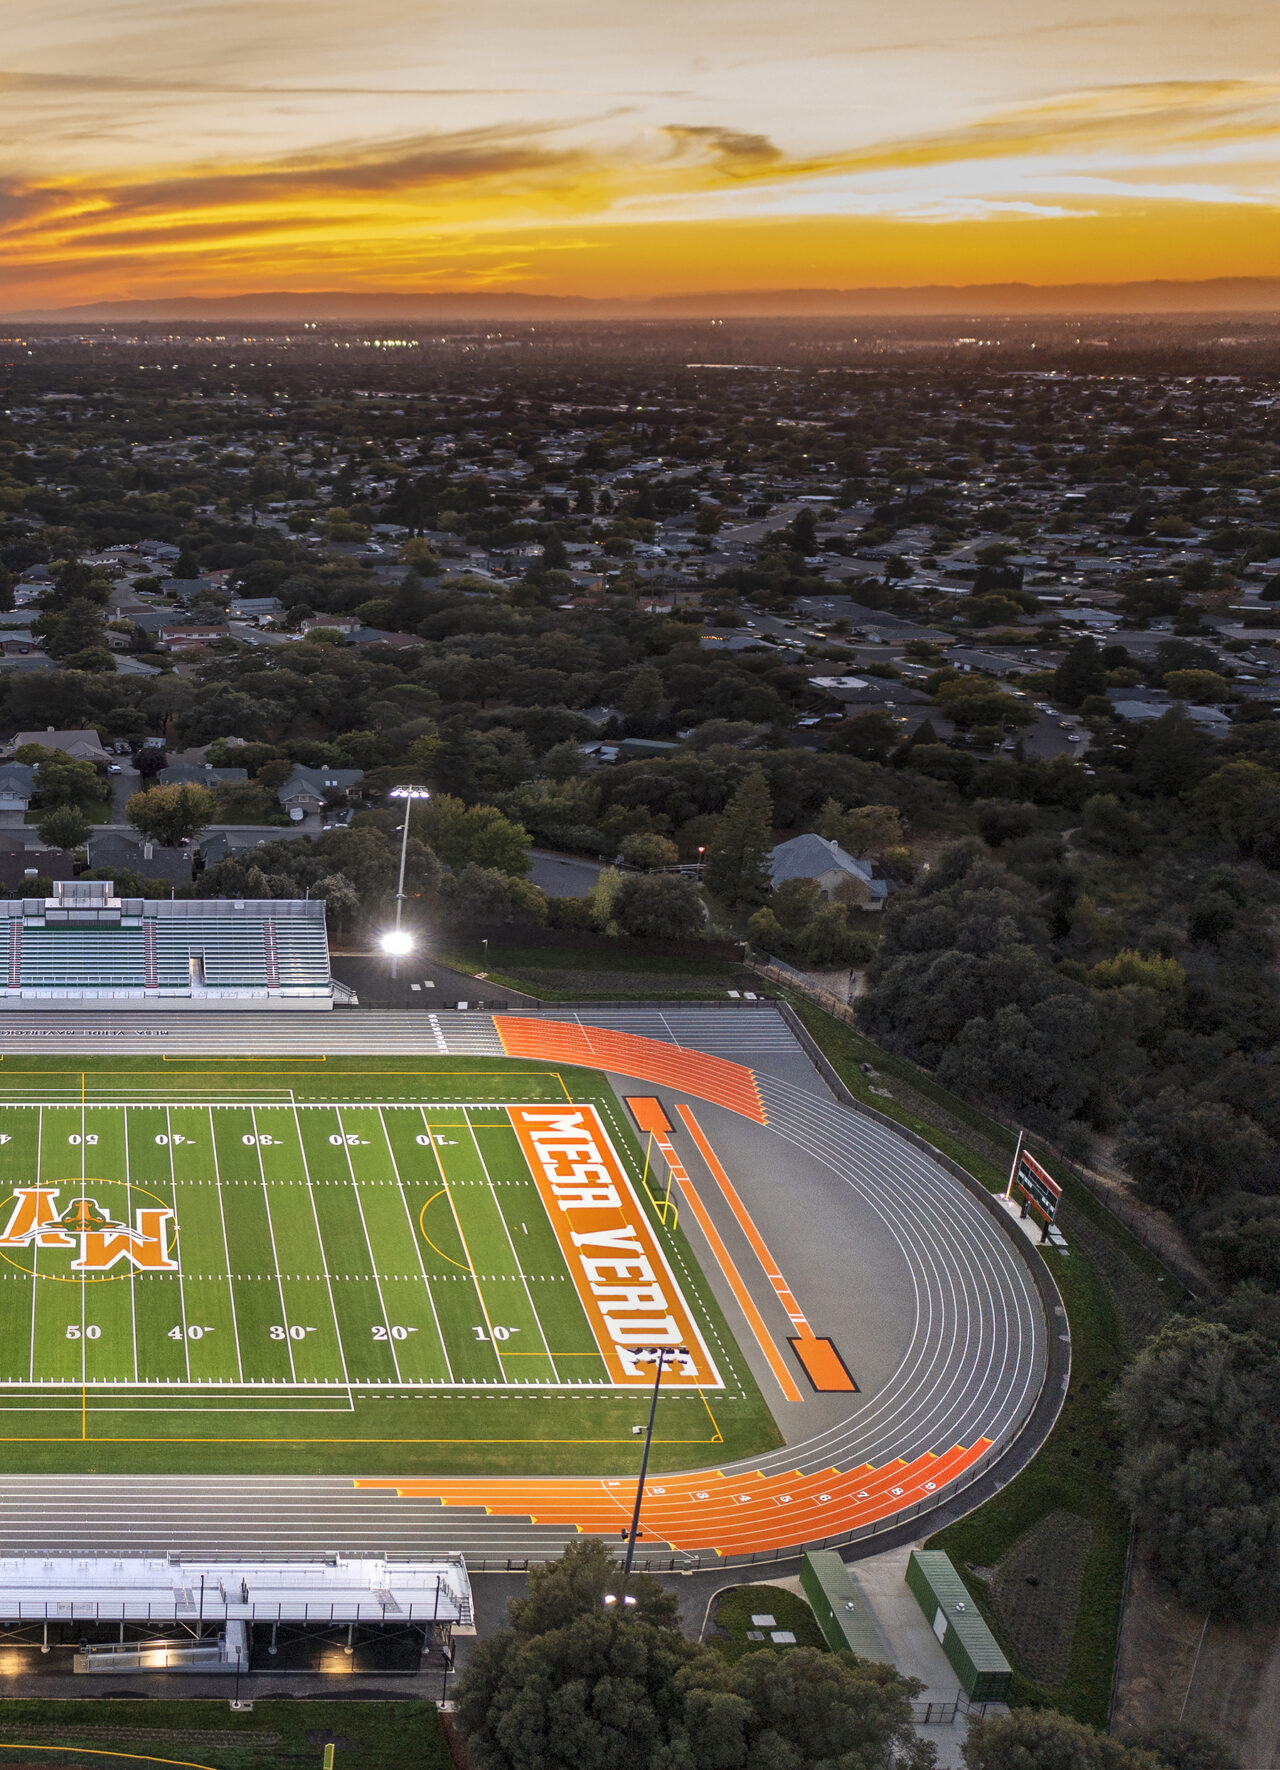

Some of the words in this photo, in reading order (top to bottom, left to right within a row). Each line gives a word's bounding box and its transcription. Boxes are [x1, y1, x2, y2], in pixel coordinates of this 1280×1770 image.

[68, 1133, 99, 1145] 50
[154, 1133, 186, 1145] 40
[241, 1133, 273, 1145] 30
[328, 1133, 360, 1145] 20
[415, 1133, 449, 1145] 10
[521, 1111, 623, 1212] MESA
[571, 1224, 700, 1377] VERDE
[65, 1323, 102, 1340] 50
[167, 1323, 204, 1340] 40
[269, 1323, 306, 1340] 30
[371, 1323, 408, 1340] 20
[472, 1323, 509, 1340] 10
[653, 1487, 666, 1495] 2
[891, 1488, 904, 1496] 8
[924, 1482, 937, 1491] 9
[696, 1492, 709, 1500] 3
[738, 1495, 752, 1503] 4
[780, 1495, 793, 1503] 5
[819, 1494, 832, 1503] 6
[857, 1491, 870, 1499] 7
